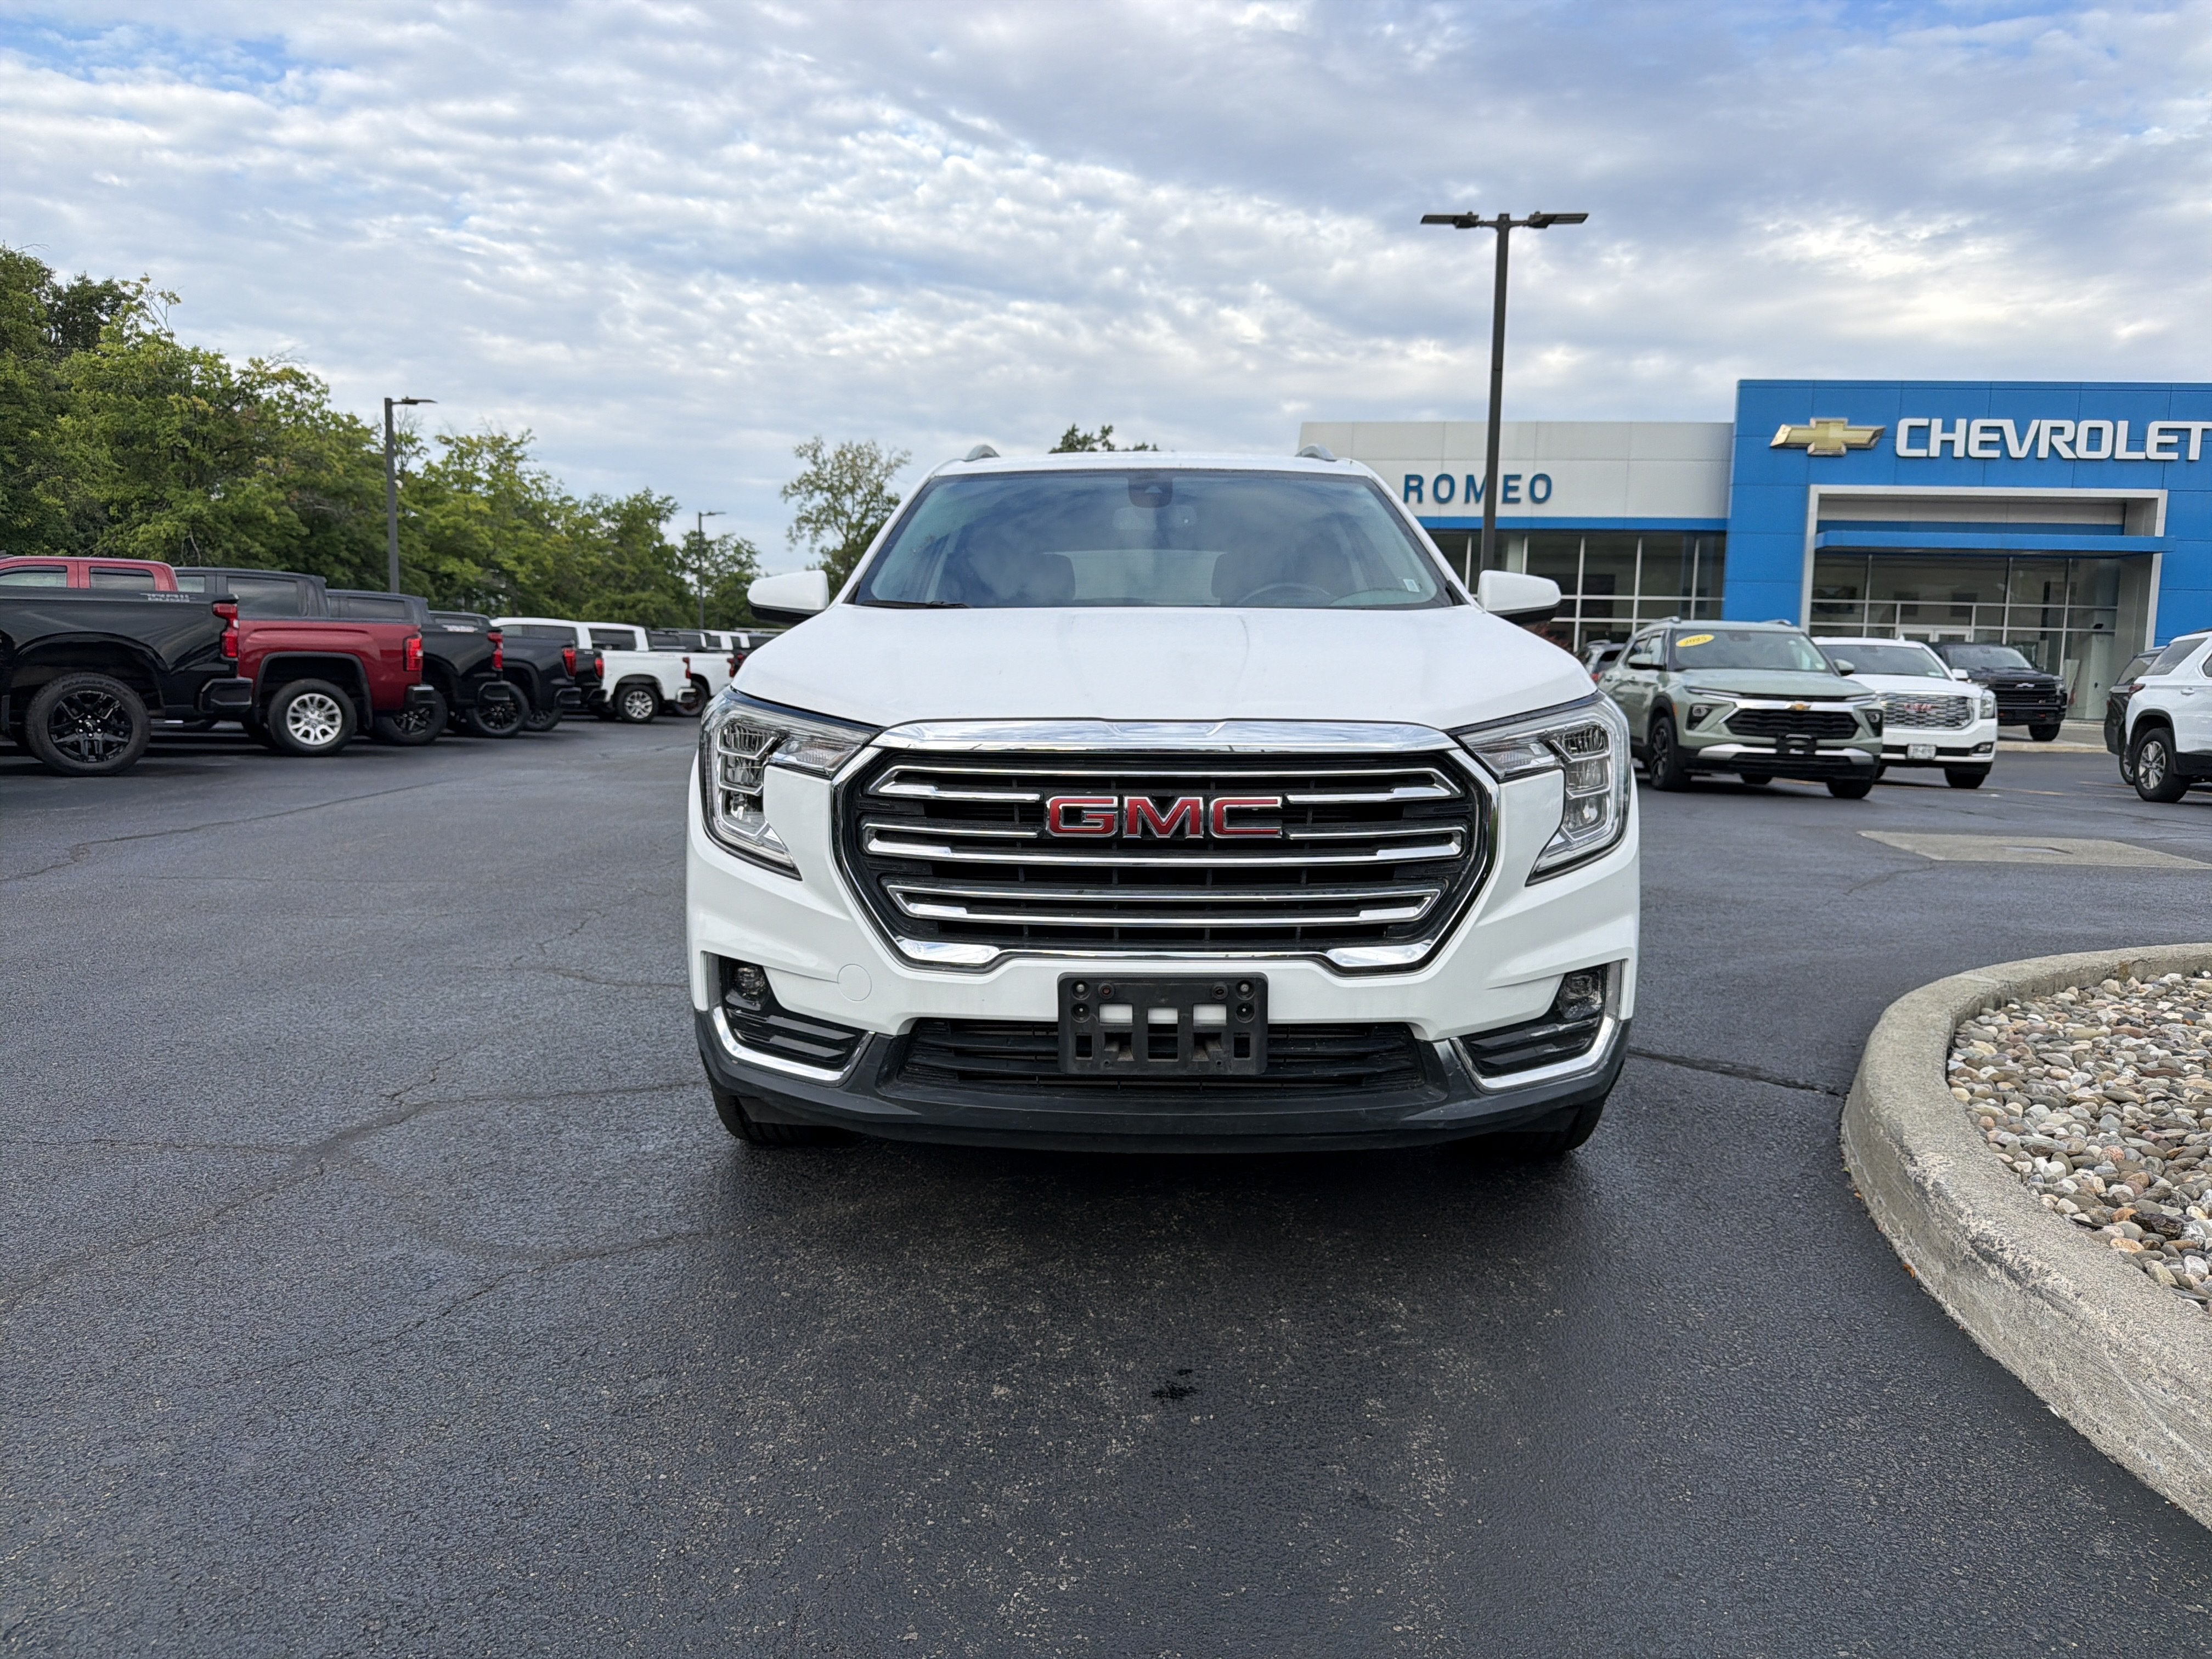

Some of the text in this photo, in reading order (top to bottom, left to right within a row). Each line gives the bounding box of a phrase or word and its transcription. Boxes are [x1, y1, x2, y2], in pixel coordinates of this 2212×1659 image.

[1895, 417, 2212, 461] CHEVROLET
[1403, 473, 1553, 504] ROMEO
[1046, 796, 1283, 839] GMC
